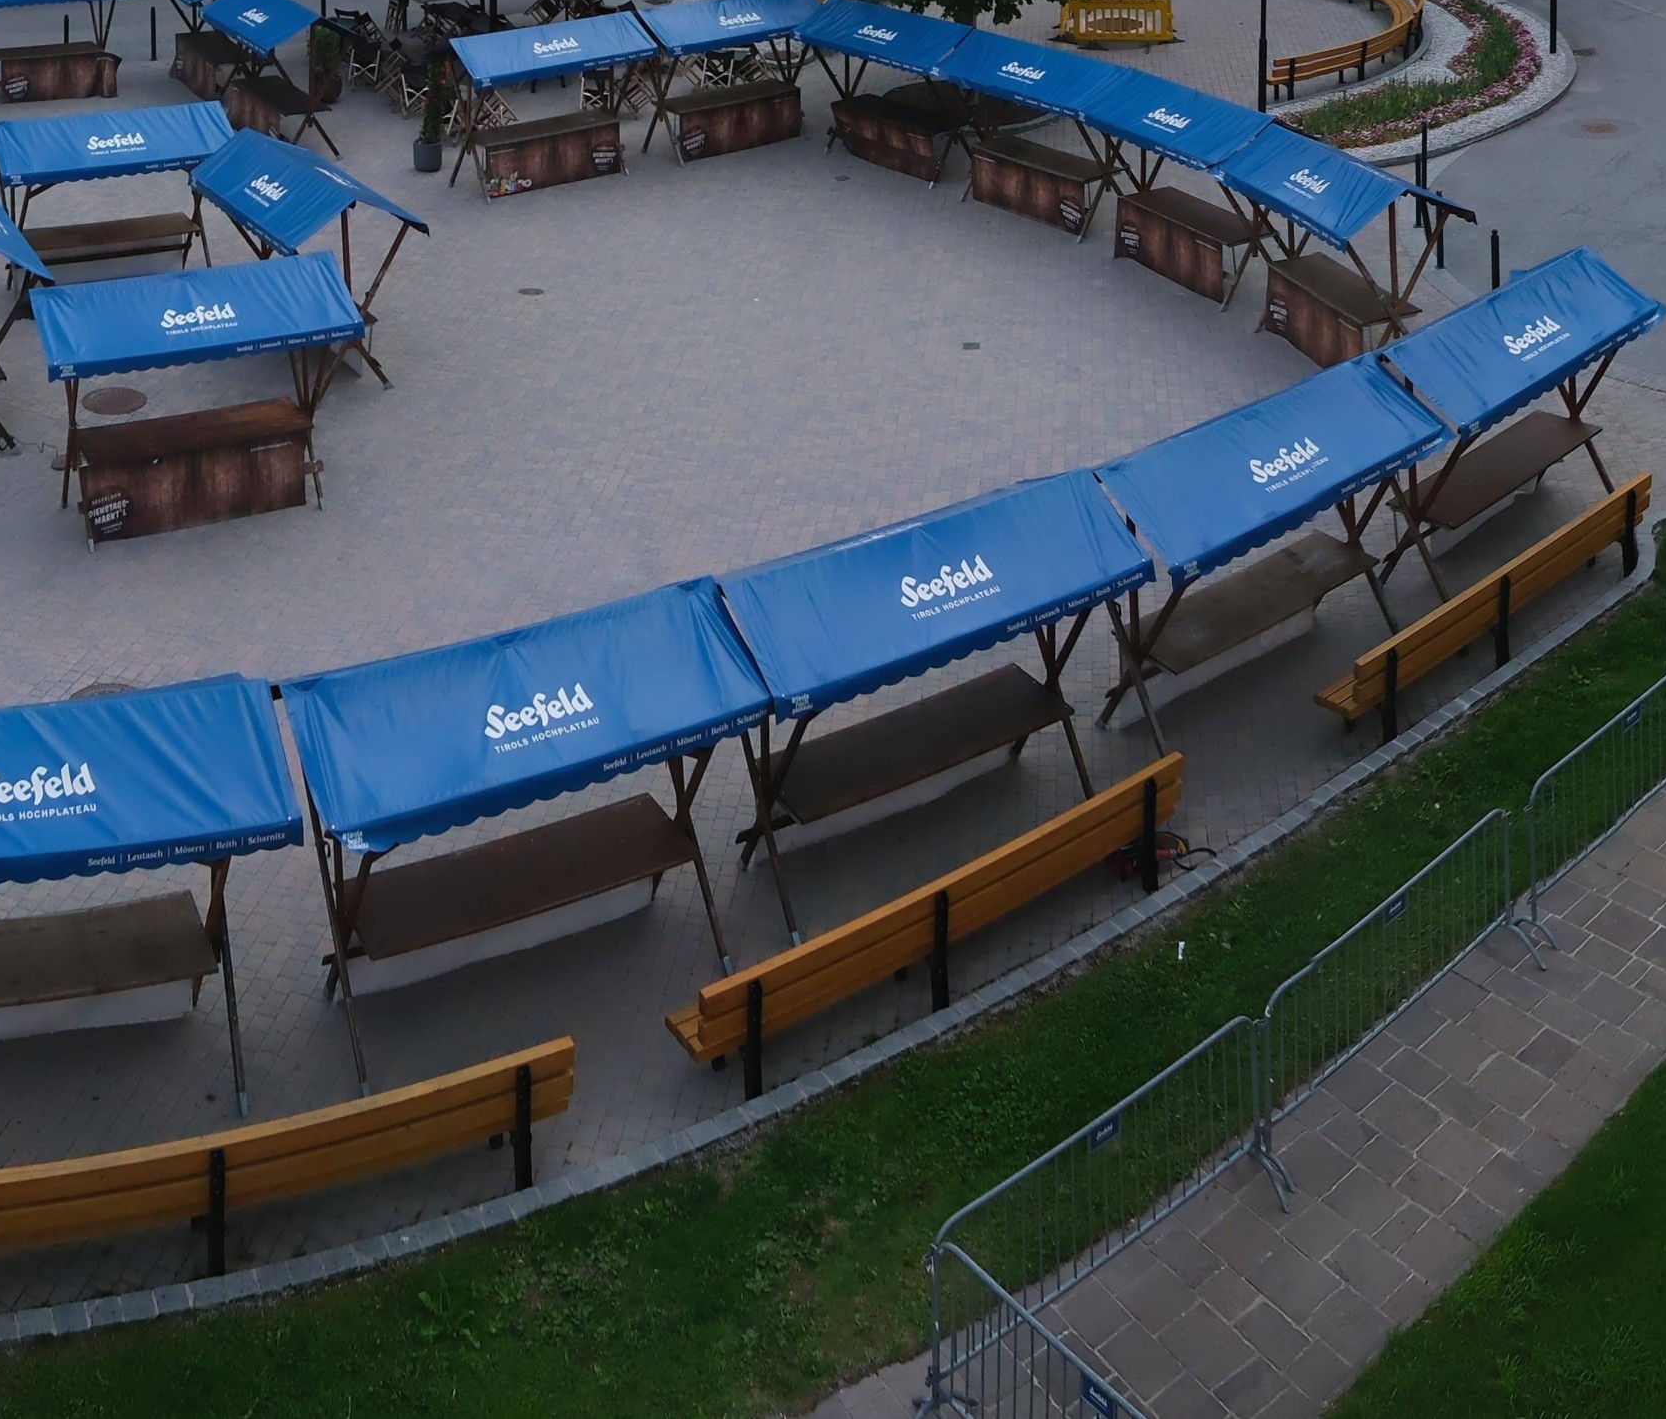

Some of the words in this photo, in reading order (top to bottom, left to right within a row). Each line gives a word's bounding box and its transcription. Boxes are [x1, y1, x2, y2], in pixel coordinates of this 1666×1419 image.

[719, 12, 762, 27] Seefeld
[533, 37, 579, 54] Seefeld
[86, 132, 145, 150] Seefeld
[160, 301, 236, 328] Seefeld
[1503, 315, 1561, 356] Seefeld
[1249, 437, 1320, 484] Seefeld
[900, 554, 994, 608] Seefeld
[911, 605, 941, 622] TIROLS
[942, 584, 1001, 612] HOCHPLATEAU
[483, 681, 594, 739] Seefeld
[494, 738, 529, 755] TIROLS
[531, 715, 600, 745] HOCHPLATEAU
[602, 757, 627, 772] Seefeld
[636, 744, 667, 760] Leutasch
[710, 722, 729, 737] Reith
[19, 803, 98, 822] HOCHPLATEAU
[87, 854, 116, 867] Seefeld
[127, 848, 163, 862] Leutasch
[174, 842, 205, 855] Mösern
[215, 837, 237, 850] Reith
[247, 830, 287, 845] Scharnitz
